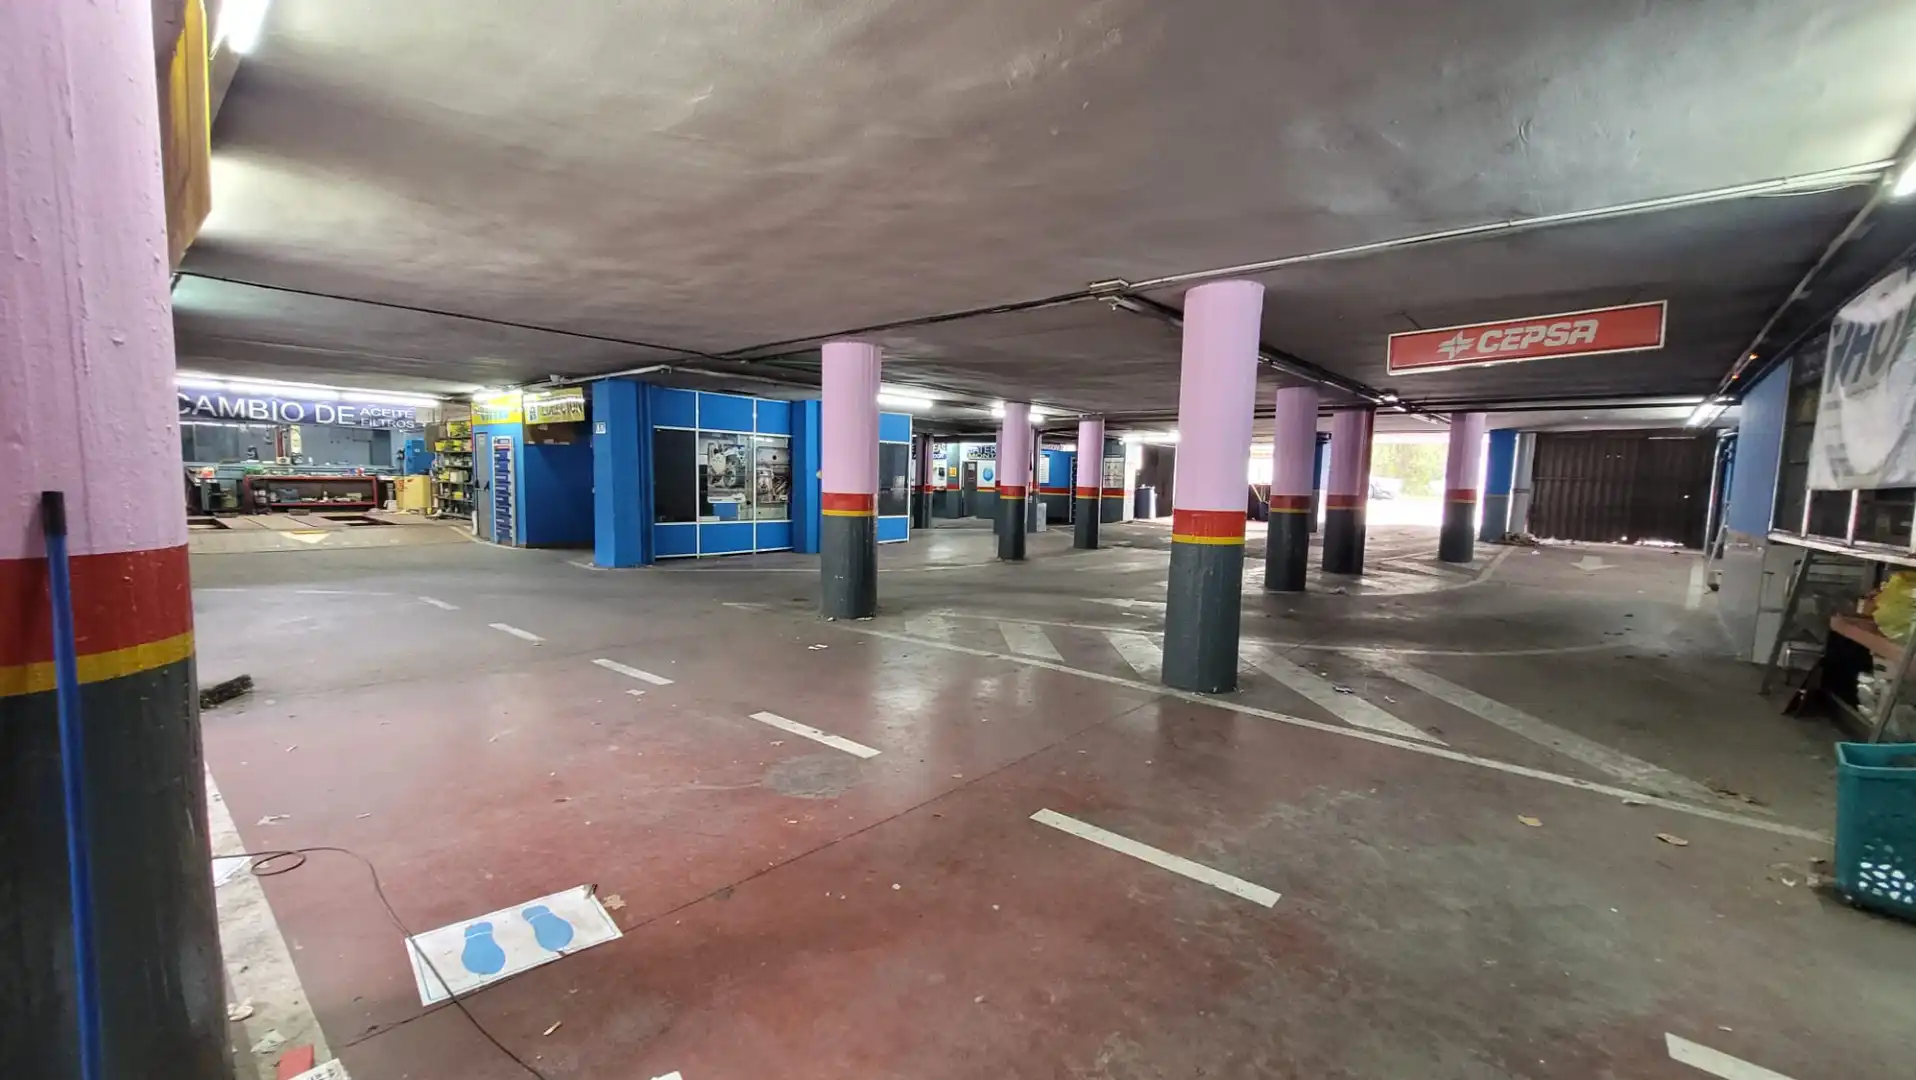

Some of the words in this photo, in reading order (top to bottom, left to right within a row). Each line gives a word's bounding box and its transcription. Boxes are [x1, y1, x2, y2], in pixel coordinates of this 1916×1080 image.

[1476, 319, 1600, 354] CEPSA
[177, 391, 305, 422] CAMBIO
[315, 402, 356, 425] DE
[359, 407, 414, 419] ACEITE
[360, 417, 415, 429] FILTROS
